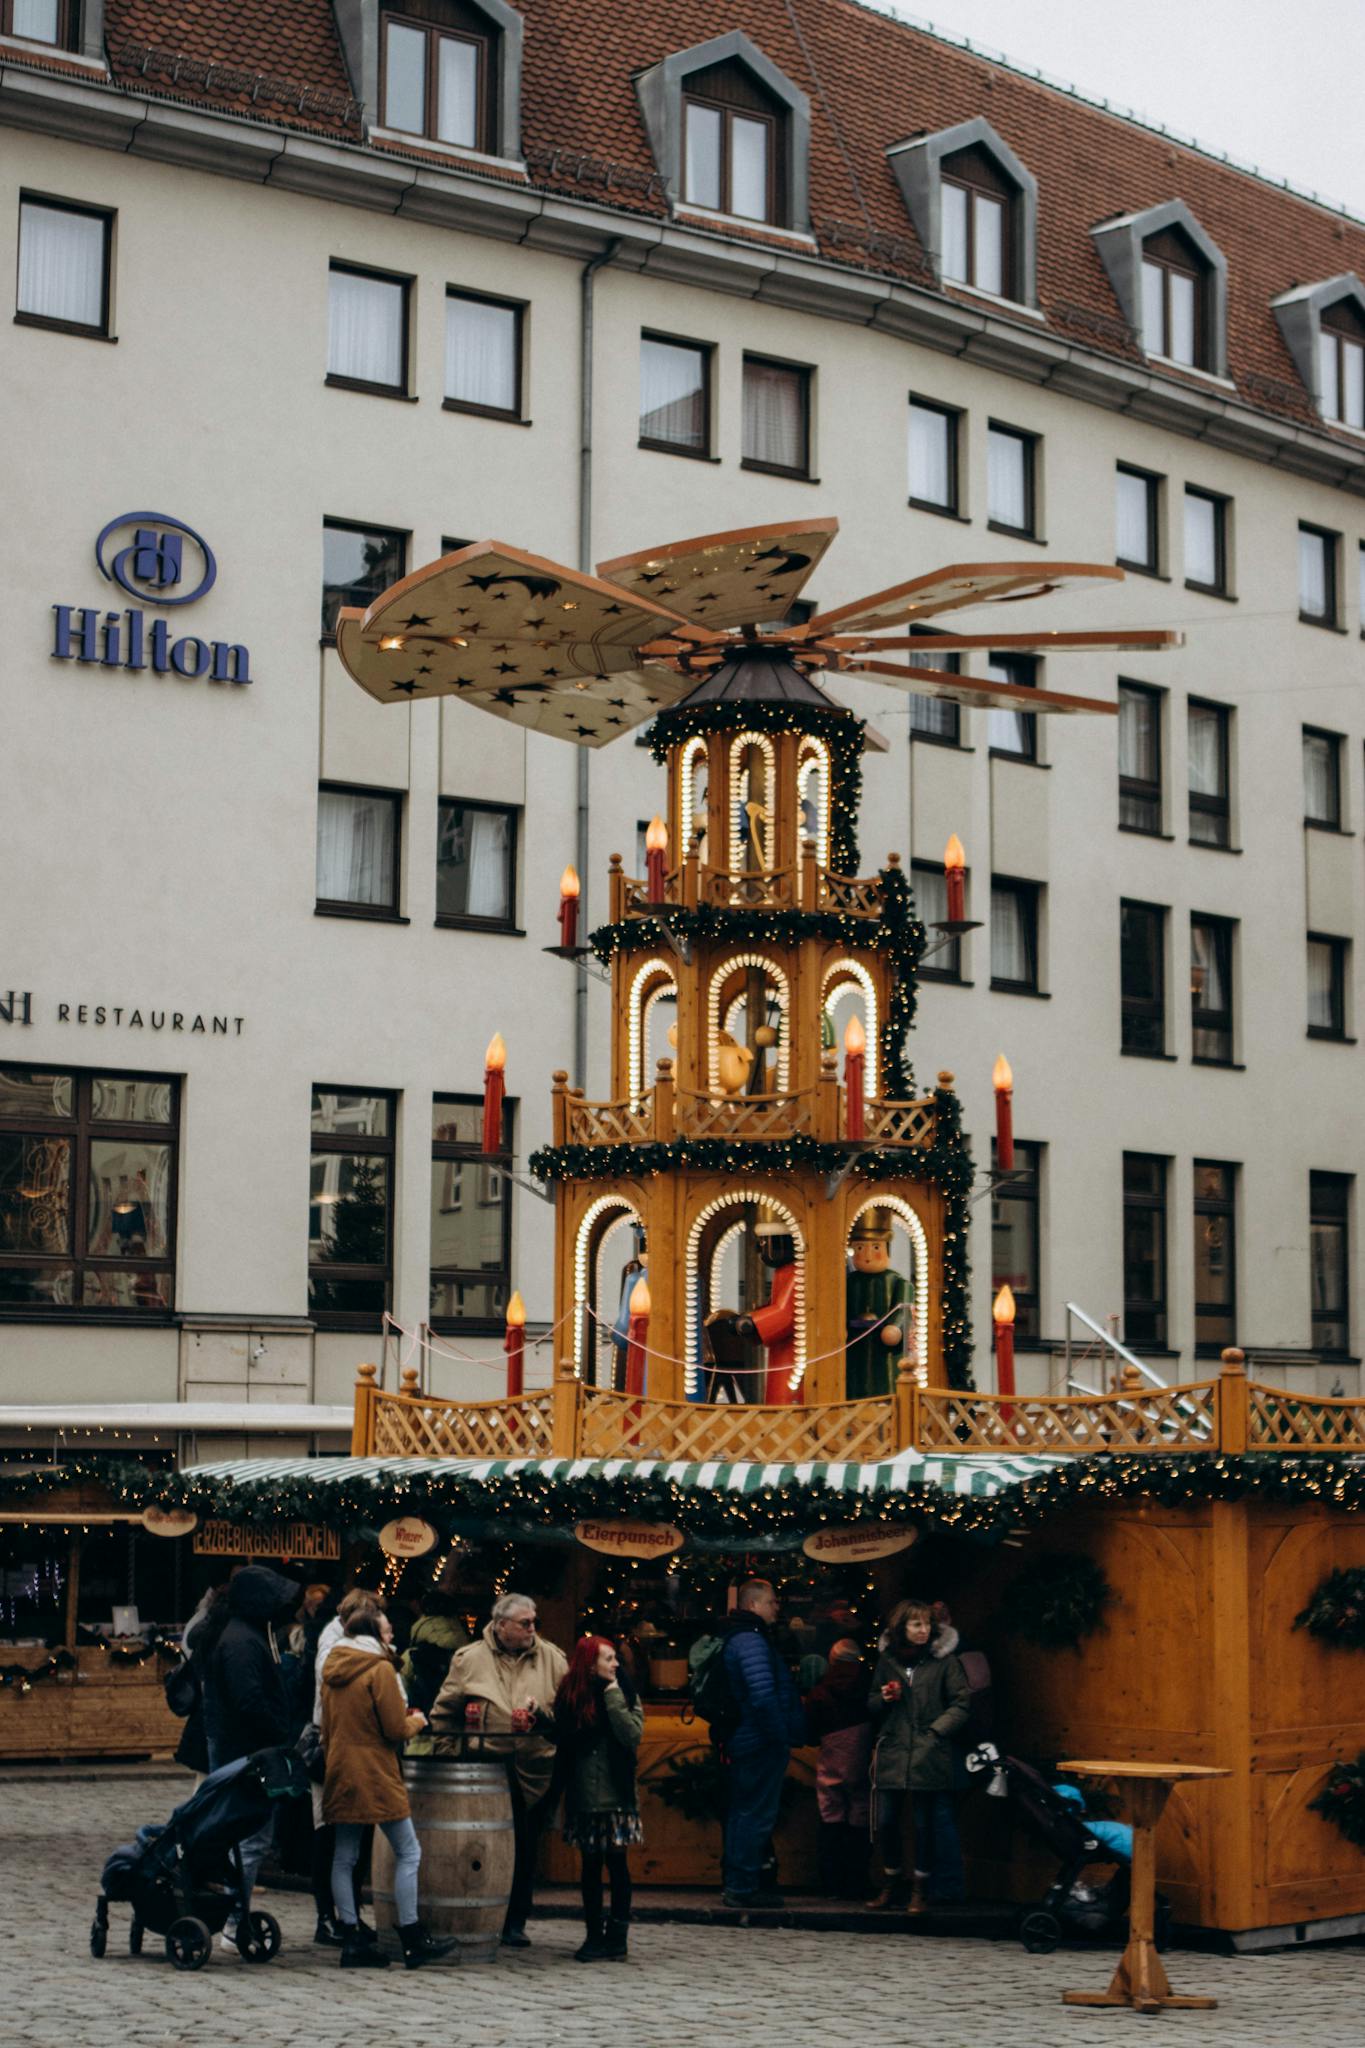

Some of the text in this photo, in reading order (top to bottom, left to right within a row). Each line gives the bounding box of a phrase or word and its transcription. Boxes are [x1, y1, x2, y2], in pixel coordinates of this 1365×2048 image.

[50, 604, 253, 684] Hilton
[58, 1003, 245, 1036] RESTAURANT
[582, 1524, 674, 1546] Eierpunsch
